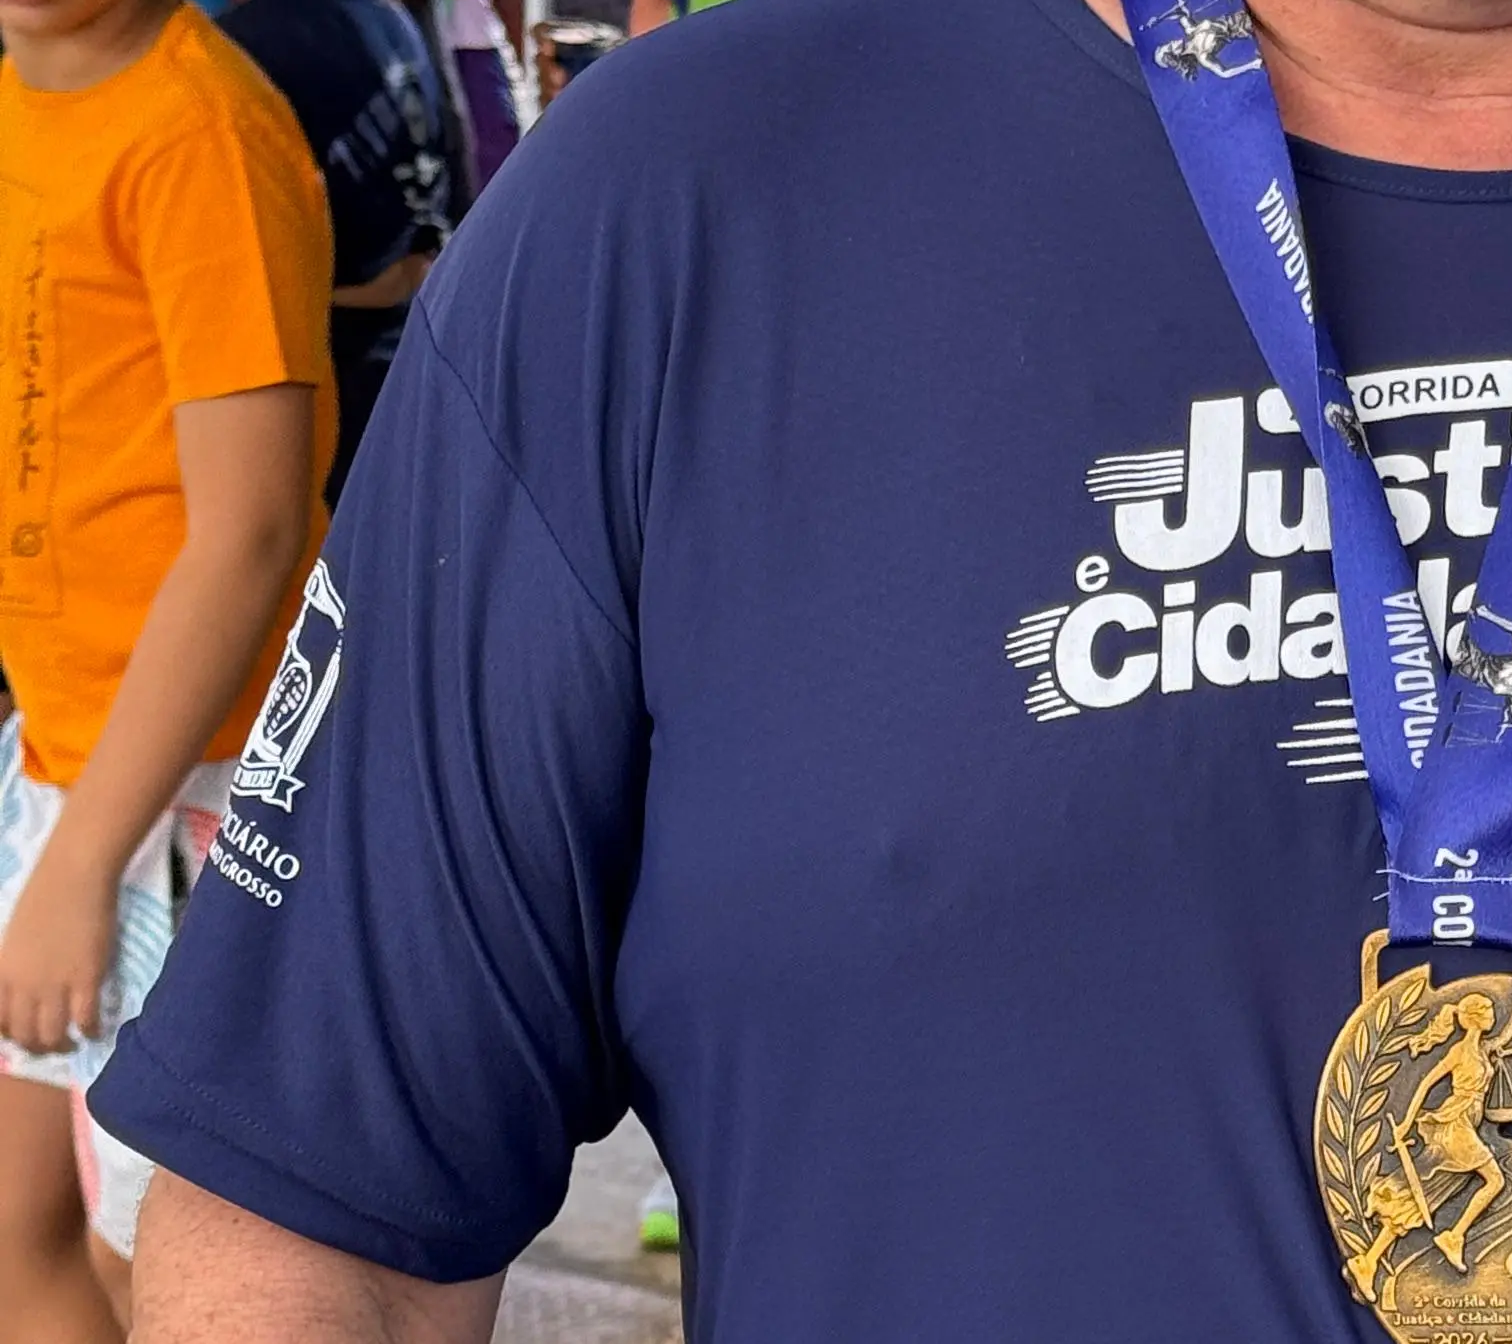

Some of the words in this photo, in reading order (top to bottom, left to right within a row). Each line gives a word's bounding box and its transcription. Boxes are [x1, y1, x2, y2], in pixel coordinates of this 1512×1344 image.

[1356, 372, 1502, 411] ORRIDA
[1075, 555, 1110, 592] e
[220, 806, 300, 880] CIÁRIO
[220, 853, 283, 907] GROSSO
[1432, 894, 1475, 947] CO
